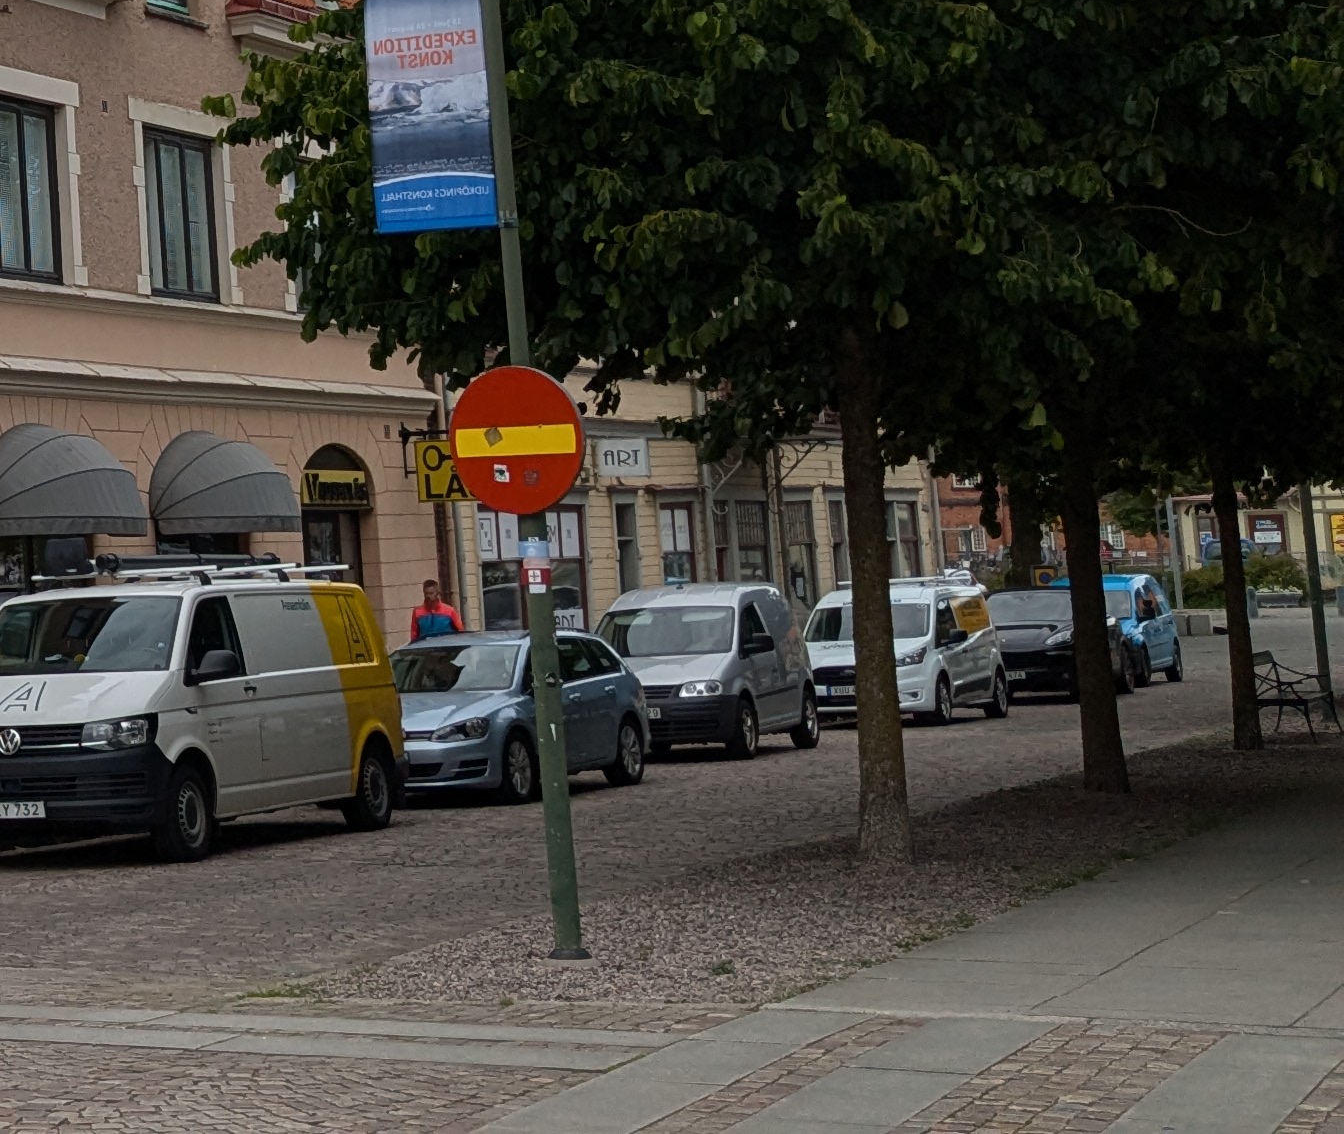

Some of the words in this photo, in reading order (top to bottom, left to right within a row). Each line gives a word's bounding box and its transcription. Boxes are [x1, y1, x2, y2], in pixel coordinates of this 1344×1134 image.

[603, 449, 641, 467] ART
[424, 465, 477, 499] LÅ
[14, 803, 40, 816] 732
